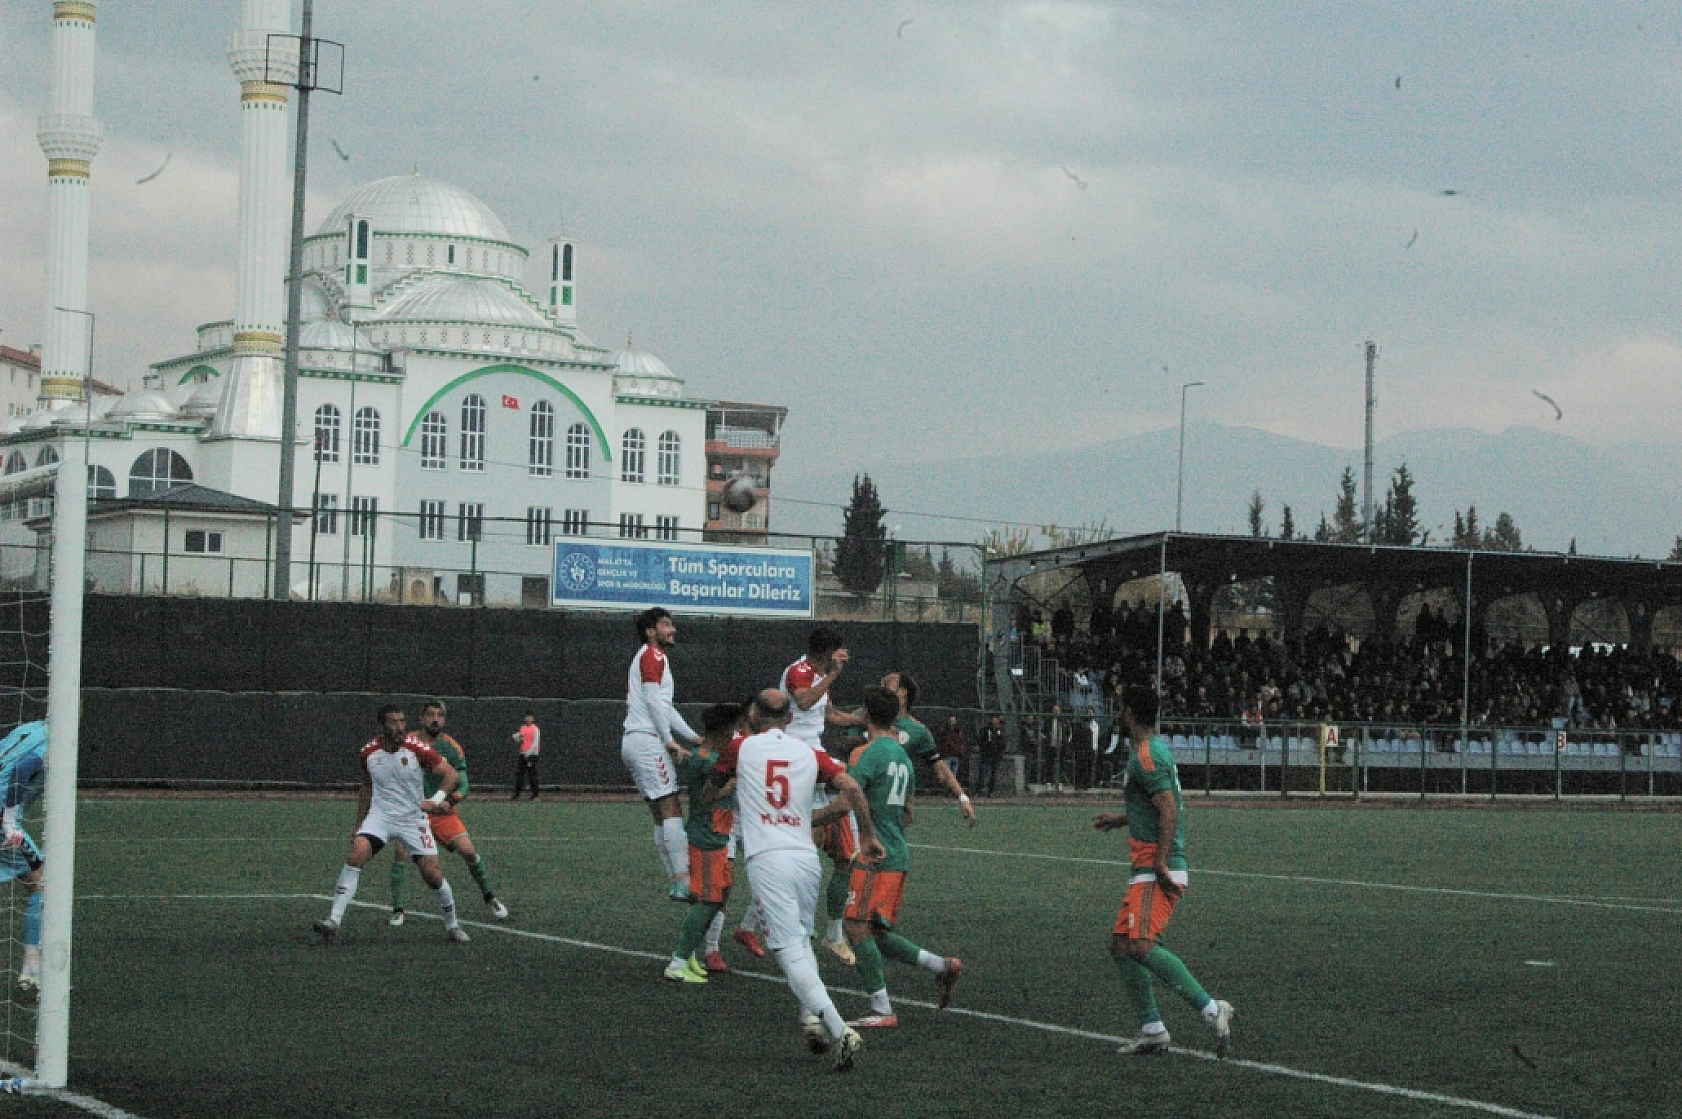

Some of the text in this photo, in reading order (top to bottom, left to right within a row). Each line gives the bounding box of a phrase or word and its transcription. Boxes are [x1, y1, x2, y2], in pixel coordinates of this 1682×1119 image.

[668, 556, 795, 579] Tüm Sporculara
[669, 580, 802, 601] Başarılar Dileriz
[1327, 728, 1337, 745] A
[765, 760, 789, 809] 5
[421, 834, 435, 849] 12
